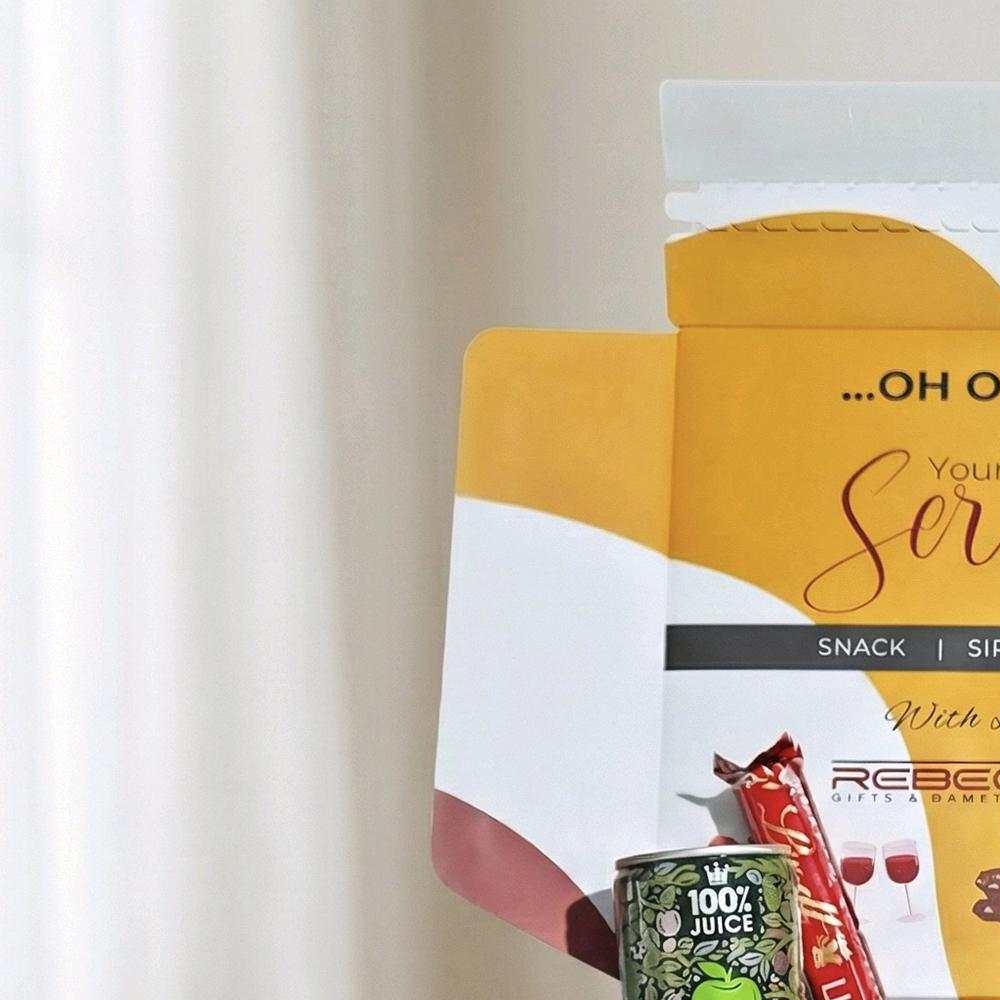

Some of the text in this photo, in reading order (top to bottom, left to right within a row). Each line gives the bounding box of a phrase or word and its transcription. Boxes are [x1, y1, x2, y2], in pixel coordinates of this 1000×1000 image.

[818, 638, 906, 658] SNACK
[885, 700, 981, 731] With
[687, 886, 754, 937] 100% JUICE
